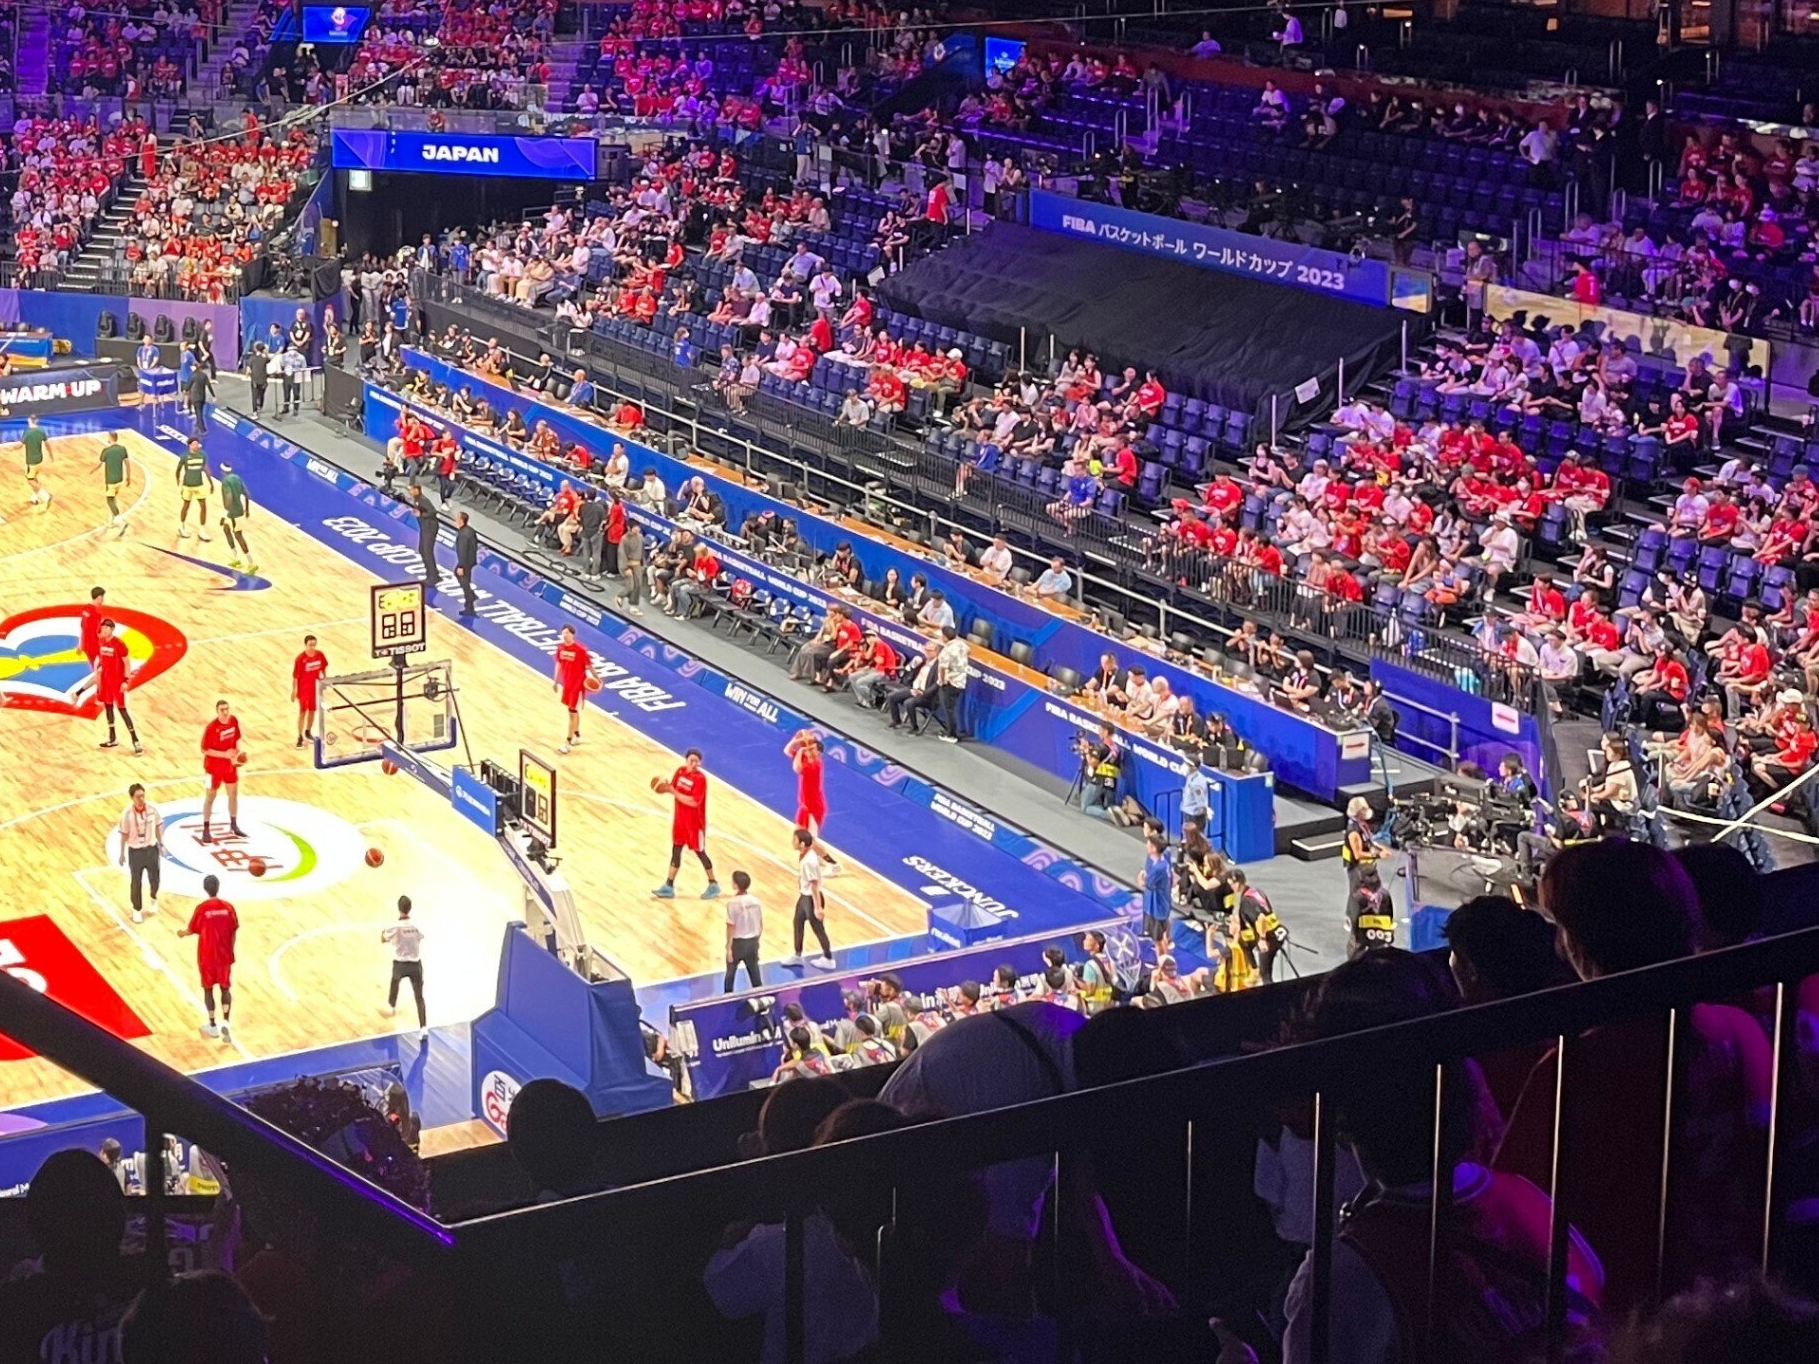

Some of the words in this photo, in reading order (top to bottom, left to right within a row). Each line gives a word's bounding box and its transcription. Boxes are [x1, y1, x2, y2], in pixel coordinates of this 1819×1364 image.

[422, 144, 499, 163] JAPAN
[1063, 215, 1096, 235] FIBA
[1098, 222, 1188, 254] バスケットボール
[1192, 242, 1293, 277] ワールドカップ
[1296, 264, 1345, 291] 2023
[0, 382, 67, 405] WARM
[70, 380, 101, 397] UP
[321, 515, 392, 544] 2023
[604, 676, 687, 712] FIBA
[724, 682, 748, 705] WIN
[756, 701, 779, 723] ALL
[1045, 701, 1068, 720] FIBA
[1132, 743, 1169, 769] WORLD
[901, 854, 1019, 919] JUNCKERS
